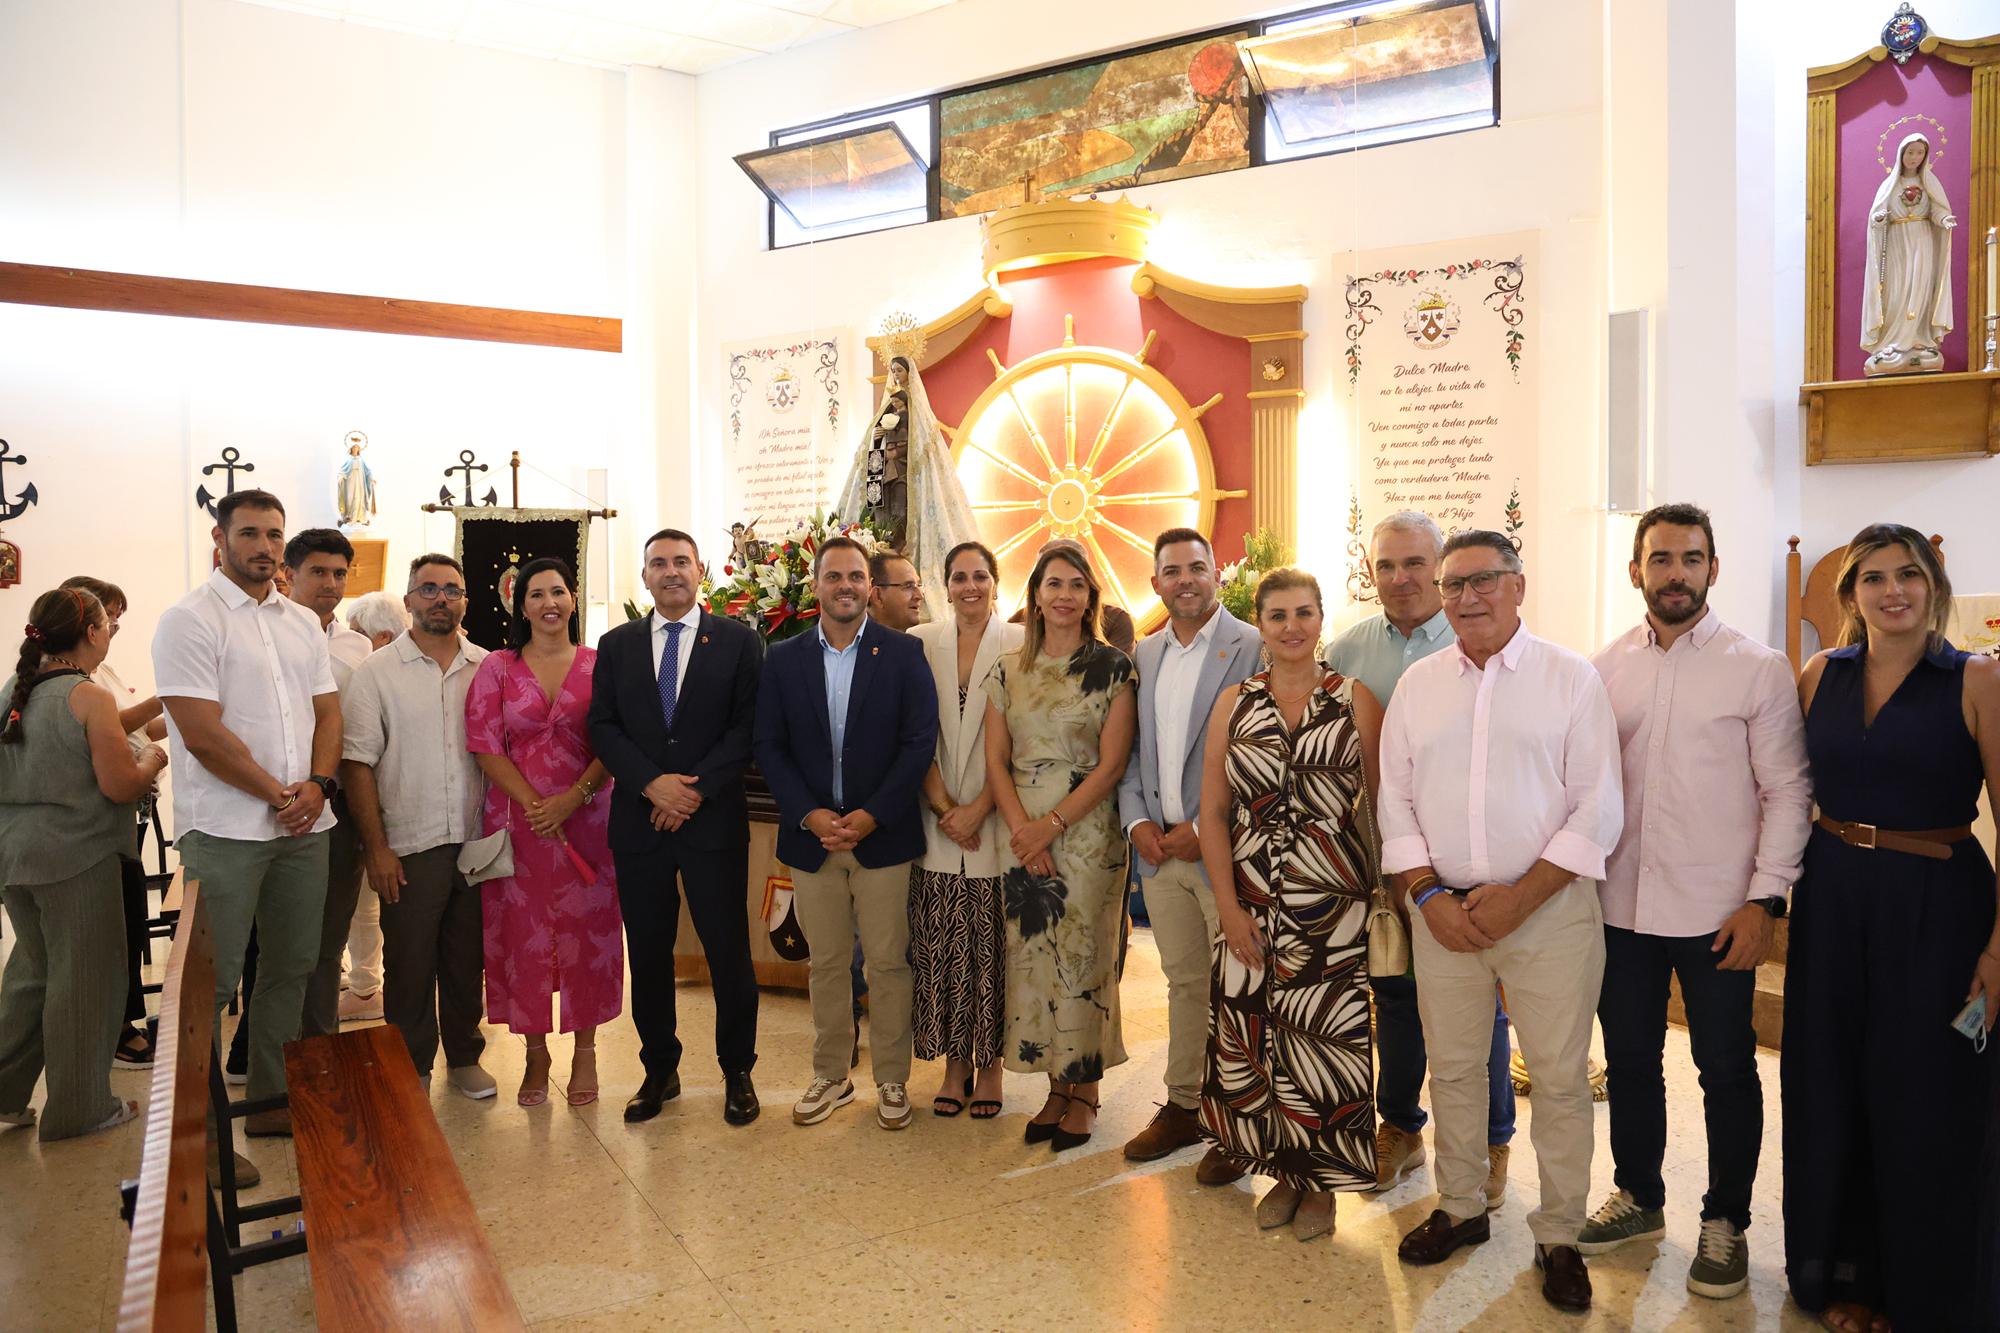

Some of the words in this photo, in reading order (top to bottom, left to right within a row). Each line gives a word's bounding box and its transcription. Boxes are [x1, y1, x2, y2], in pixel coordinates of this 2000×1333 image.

[1394, 364, 1425, 378] Dulce
[1395, 386, 1402, 395] te
[1437, 383, 1446, 391] tu
[1450, 381, 1470, 390] vista
[1474, 380, 1486, 389] de
[1368, 422, 1389, 432] Ven
[1392, 421, 1428, 434] conmigo
[1442, 418, 1465, 428] todas
[1468, 416, 1498, 428] partes
[1381, 442, 1386, 451] y
[1422, 436, 1439, 447] solo
[1373, 457, 1390, 469] Ya
[1393, 460, 1409, 468] que
[1428, 455, 1465, 468] proteges
[1469, 453, 1493, 463] tanto
[1401, 474, 1449, 483] verdadera
[1384, 492, 1405, 503] Haz
[1409, 495, 1425, 503] que
[1445, 491, 1481, 504] bendiga
[1439, 508, 1448, 518] el
[1450, 508, 1474, 521] Hijo
